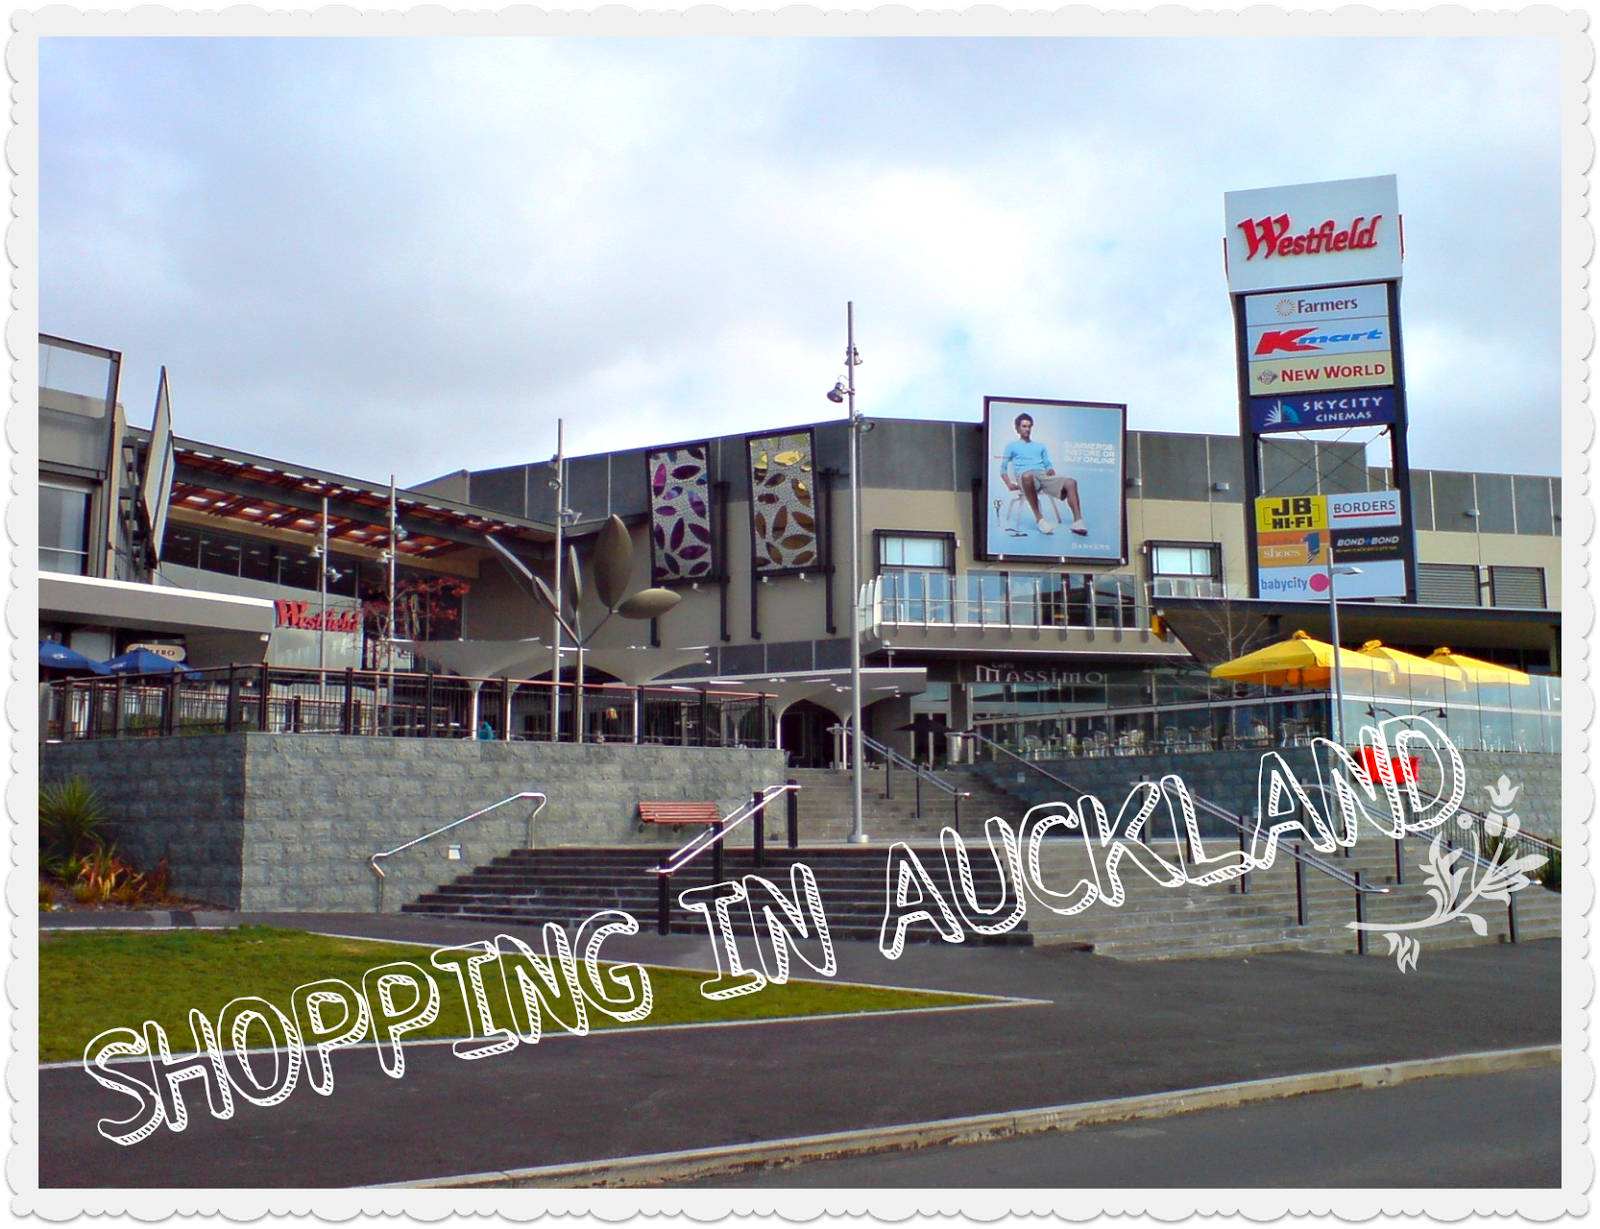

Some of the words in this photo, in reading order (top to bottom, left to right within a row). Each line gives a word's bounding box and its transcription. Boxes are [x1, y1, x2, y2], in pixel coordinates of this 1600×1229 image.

[1237, 213, 1382, 261] Westfield
[1297, 297, 1358, 313] Farmers
[1254, 327, 1383, 355] Kmart
[1281, 368, 1320, 382] NEW
[1324, 364, 1386, 380] WORLD
[1302, 396, 1383, 411] SKYCITY
[1315, 411, 1372, 422] CINEMAS
[1083, 456, 1116, 465] ONLINE
[1272, 498, 1312, 516] JB
[1333, 500, 1396, 513] BORDERS
[1263, 548, 1300, 558] shoes
[1261, 576, 1308, 592] babycity
[274, 599, 362, 633] Westfield
